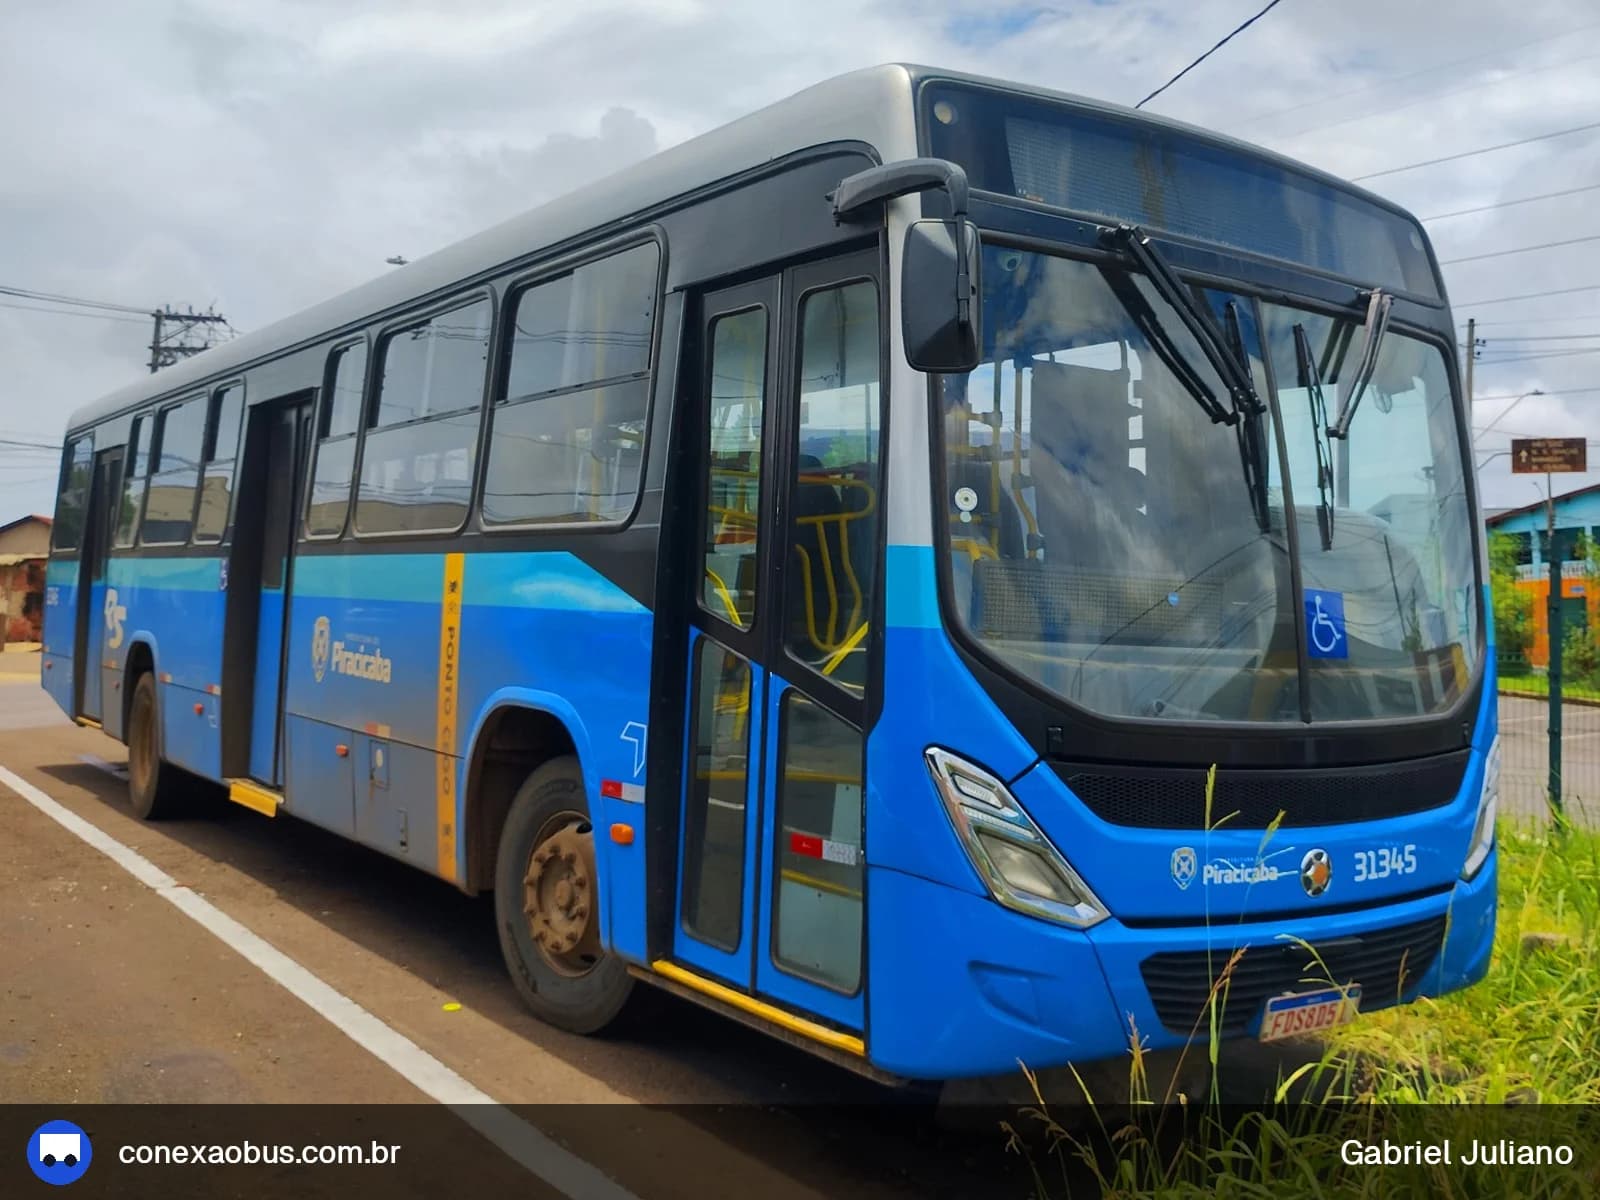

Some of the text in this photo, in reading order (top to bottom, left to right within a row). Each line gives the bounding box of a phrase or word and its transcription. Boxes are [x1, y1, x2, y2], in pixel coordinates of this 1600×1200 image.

[331, 641, 391, 684] Piracicaba
[1202, 863, 1278, 885] Piracicaba
[1354, 844, 1417, 882] 31345
